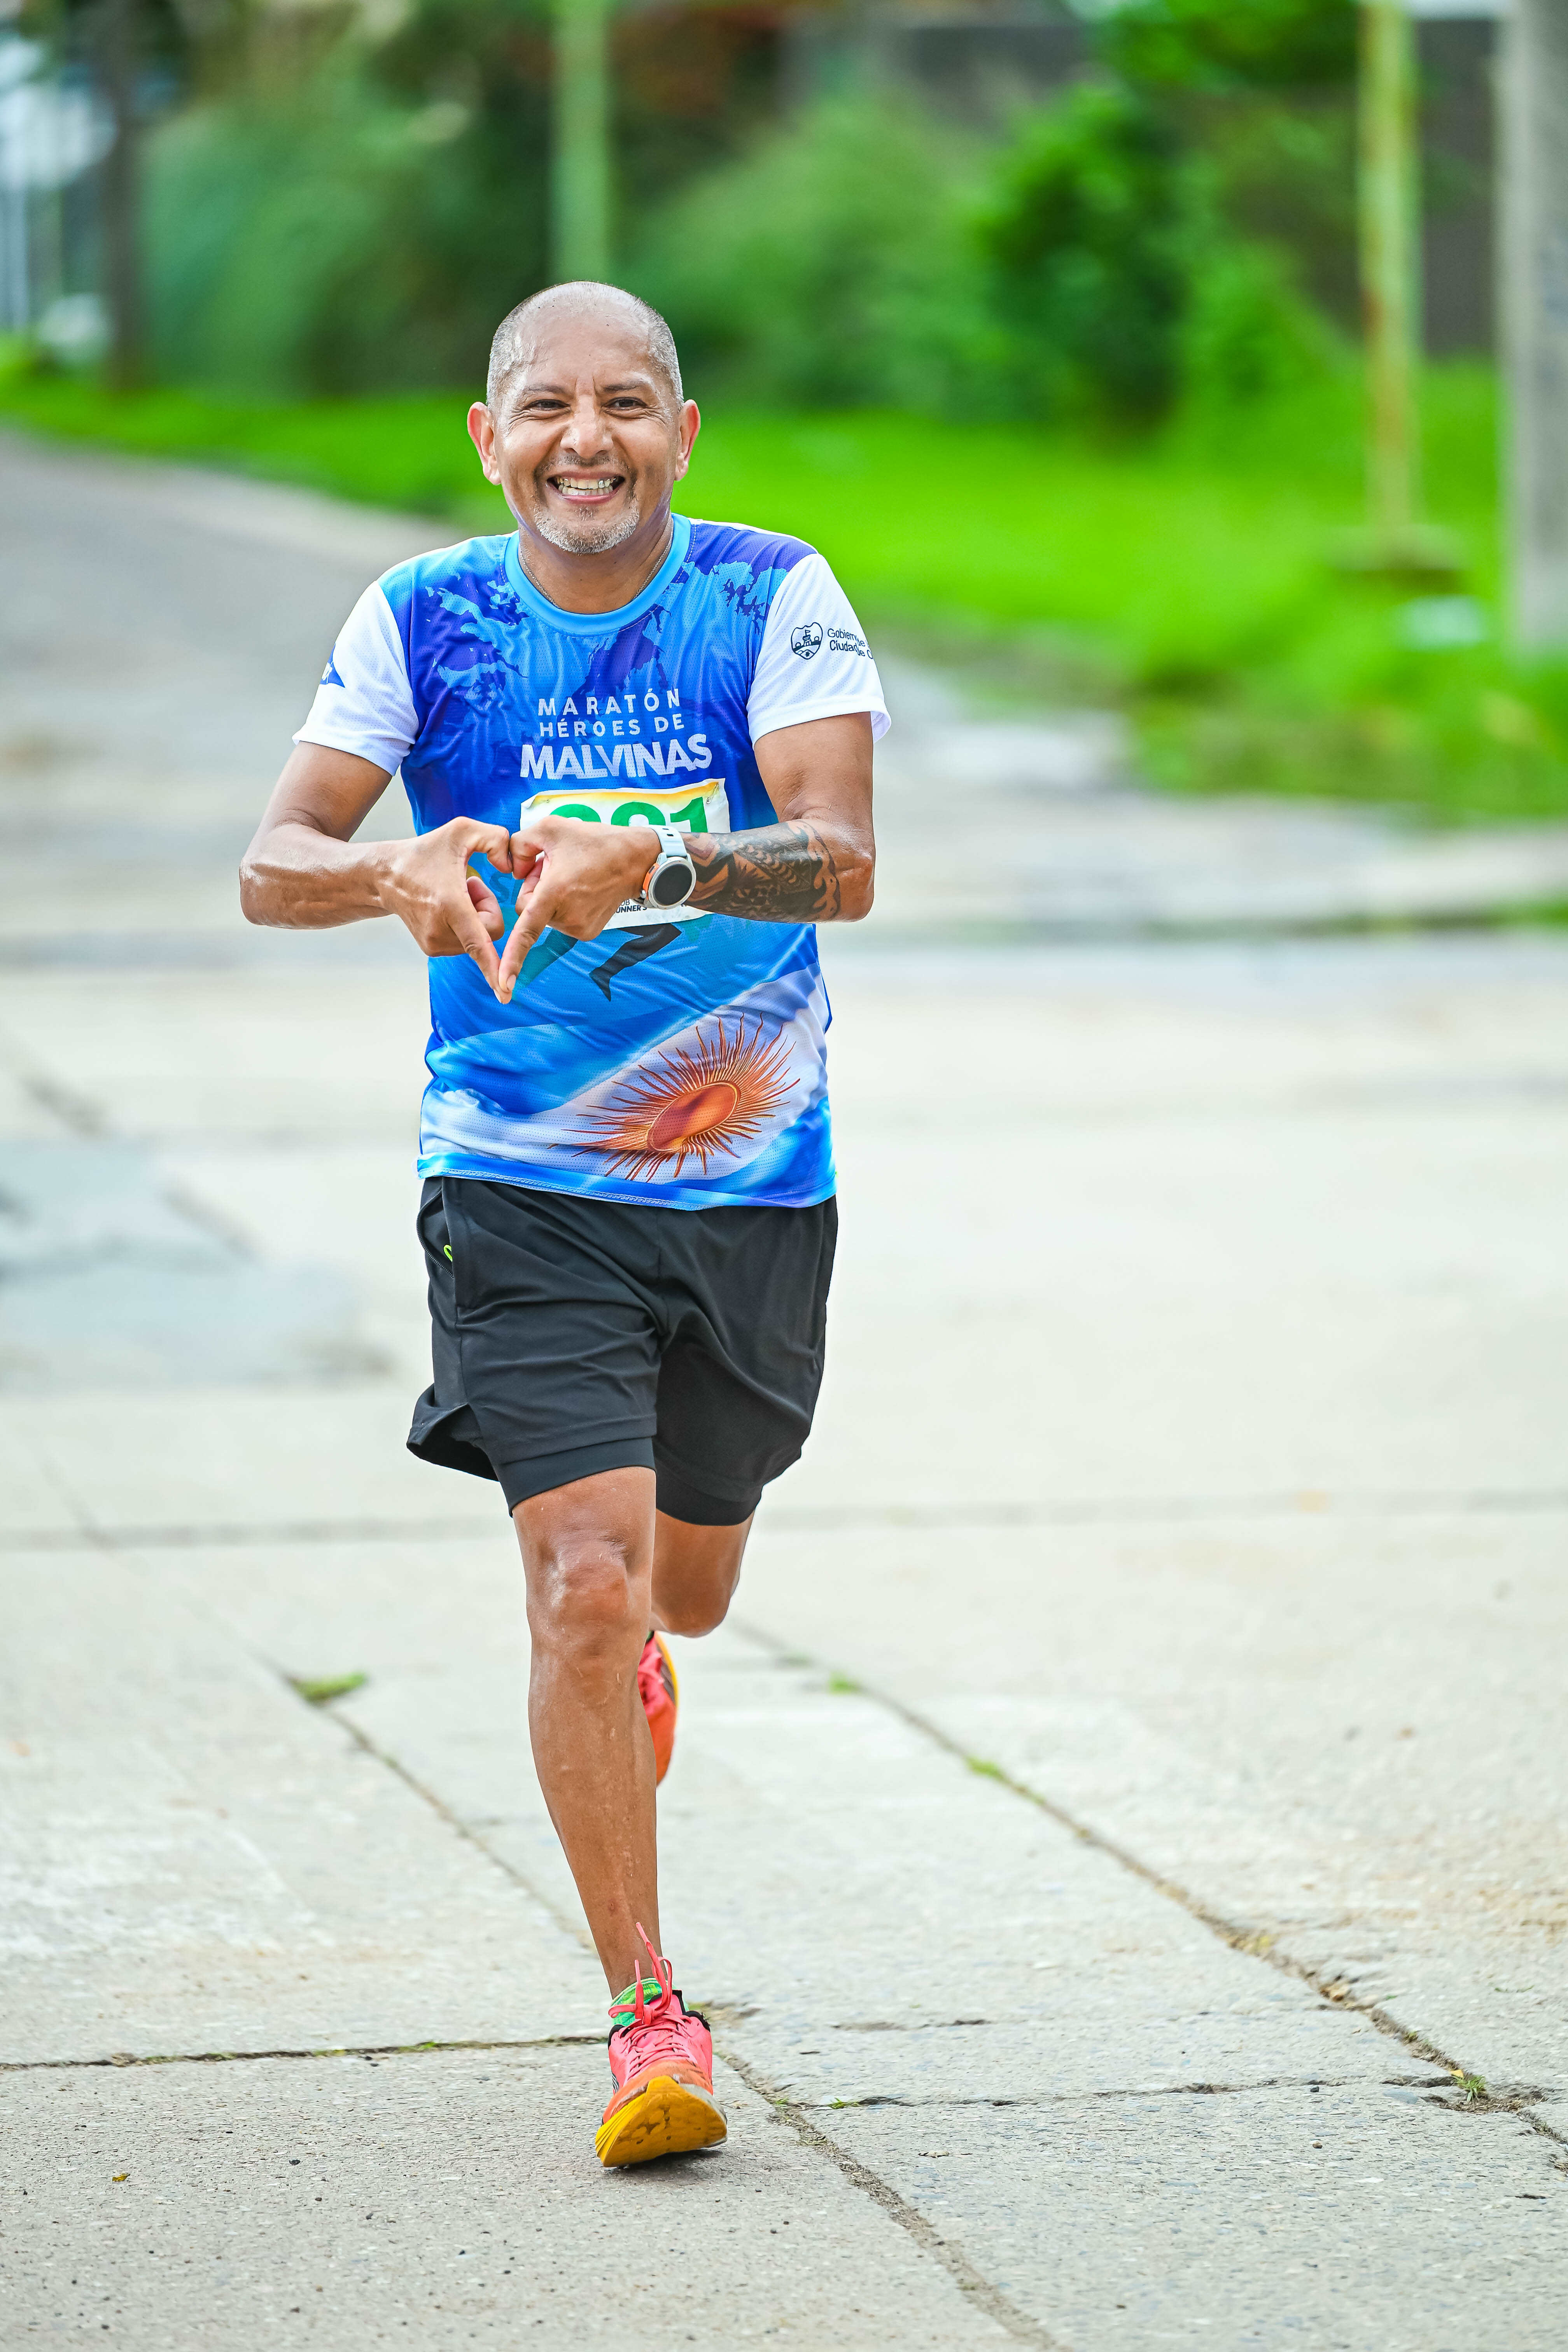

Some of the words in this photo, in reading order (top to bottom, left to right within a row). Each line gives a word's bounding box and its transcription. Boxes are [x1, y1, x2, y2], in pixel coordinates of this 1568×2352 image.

[827, 628, 857, 641] Gobiern
[538, 688, 680, 716] MARATÓN
[540, 718, 640, 737] HÉROES
[654, 713, 684, 733] DE
[520, 733, 712, 780] MALVINAS
